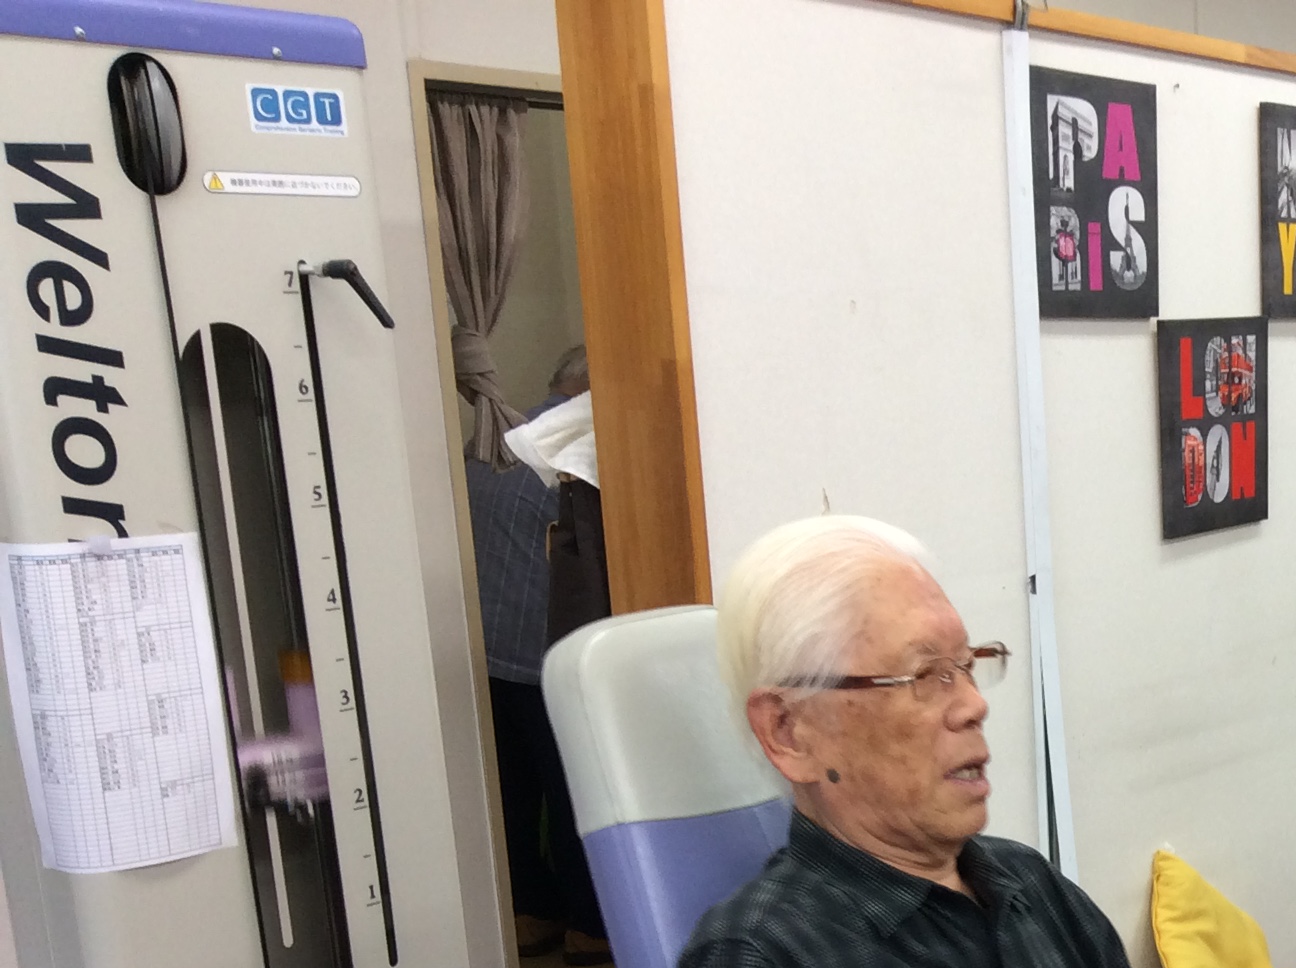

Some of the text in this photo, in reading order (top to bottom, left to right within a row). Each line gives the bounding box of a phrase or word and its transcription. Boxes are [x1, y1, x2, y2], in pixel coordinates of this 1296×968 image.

[254, 92, 337, 123] CGT
[284, 271, 294, 287] 7
[299, 379, 309, 395] 6
[313, 486, 322, 502] 5
[327, 588, 337, 605] 4
[340, 689, 350, 706] 3
[354, 788, 364, 804] 2
[368, 885, 376, 900] 1
